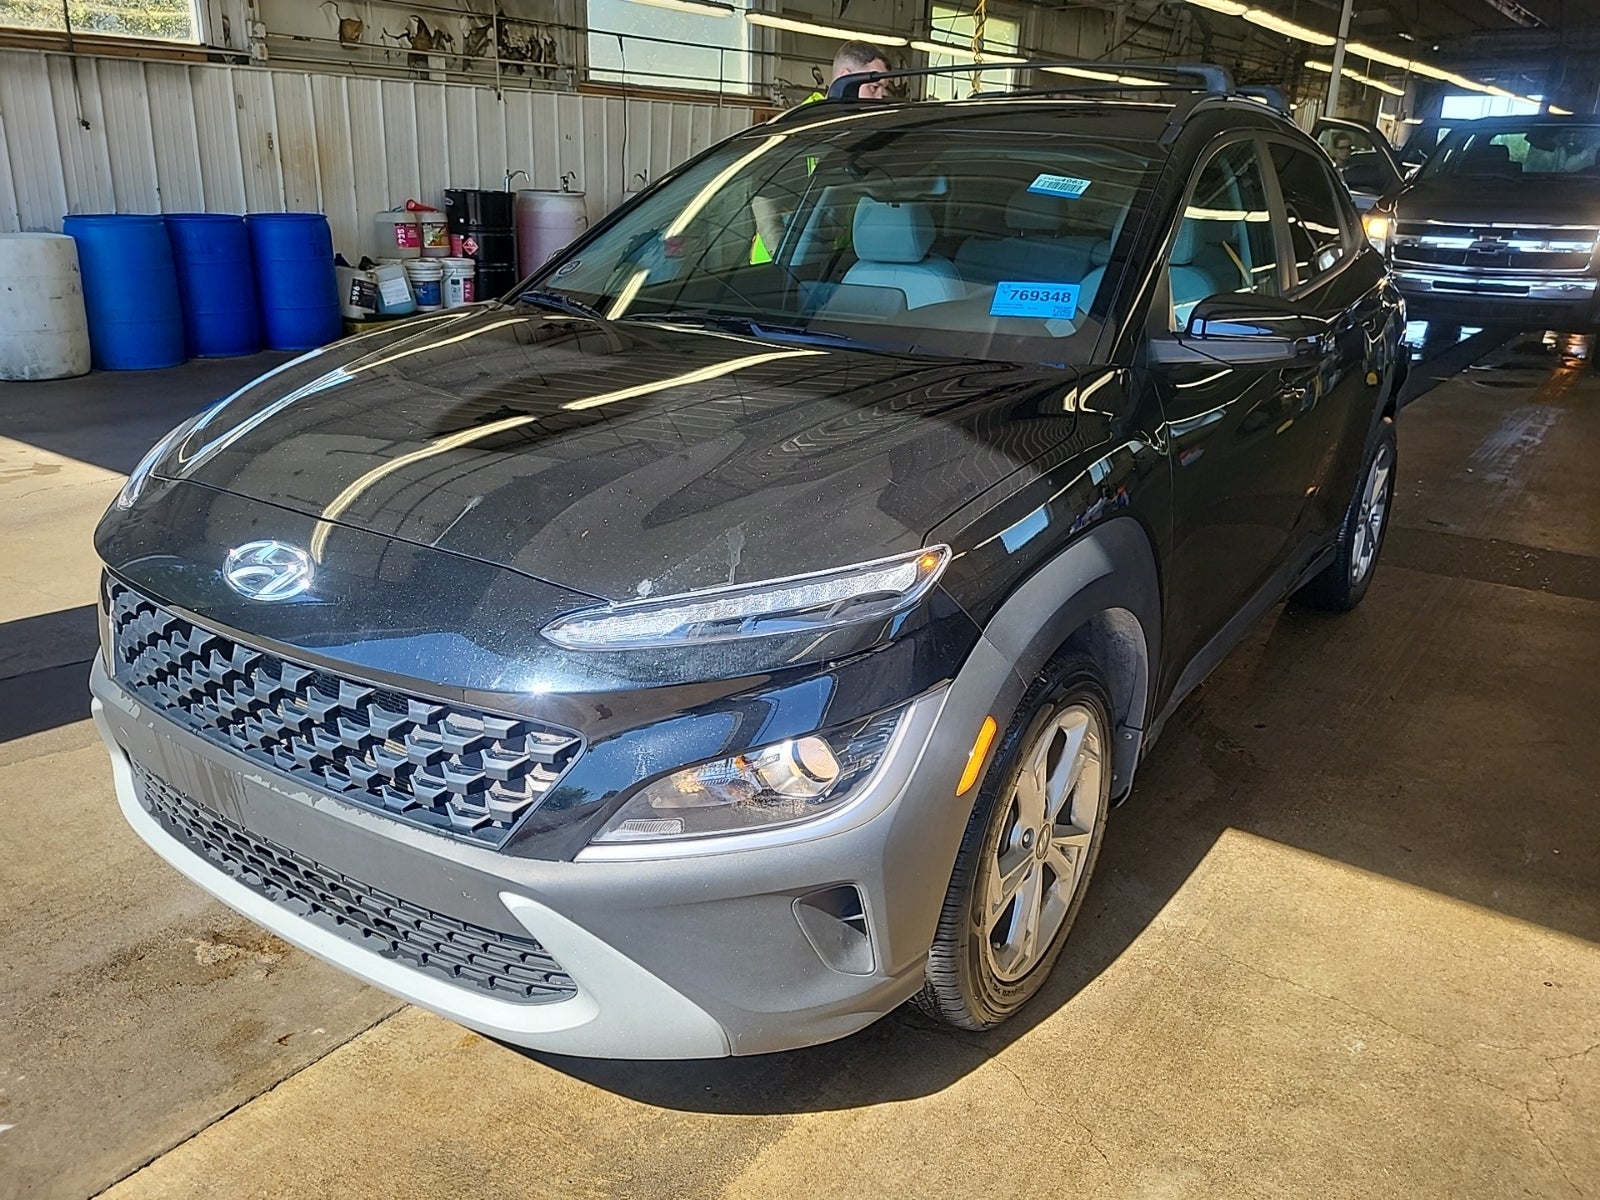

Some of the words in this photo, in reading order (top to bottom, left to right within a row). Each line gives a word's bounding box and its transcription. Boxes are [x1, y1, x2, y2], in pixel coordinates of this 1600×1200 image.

[397, 229, 406, 243] 735
[351, 285, 361, 301] 596
[1009, 289, 1072, 303] 769348
